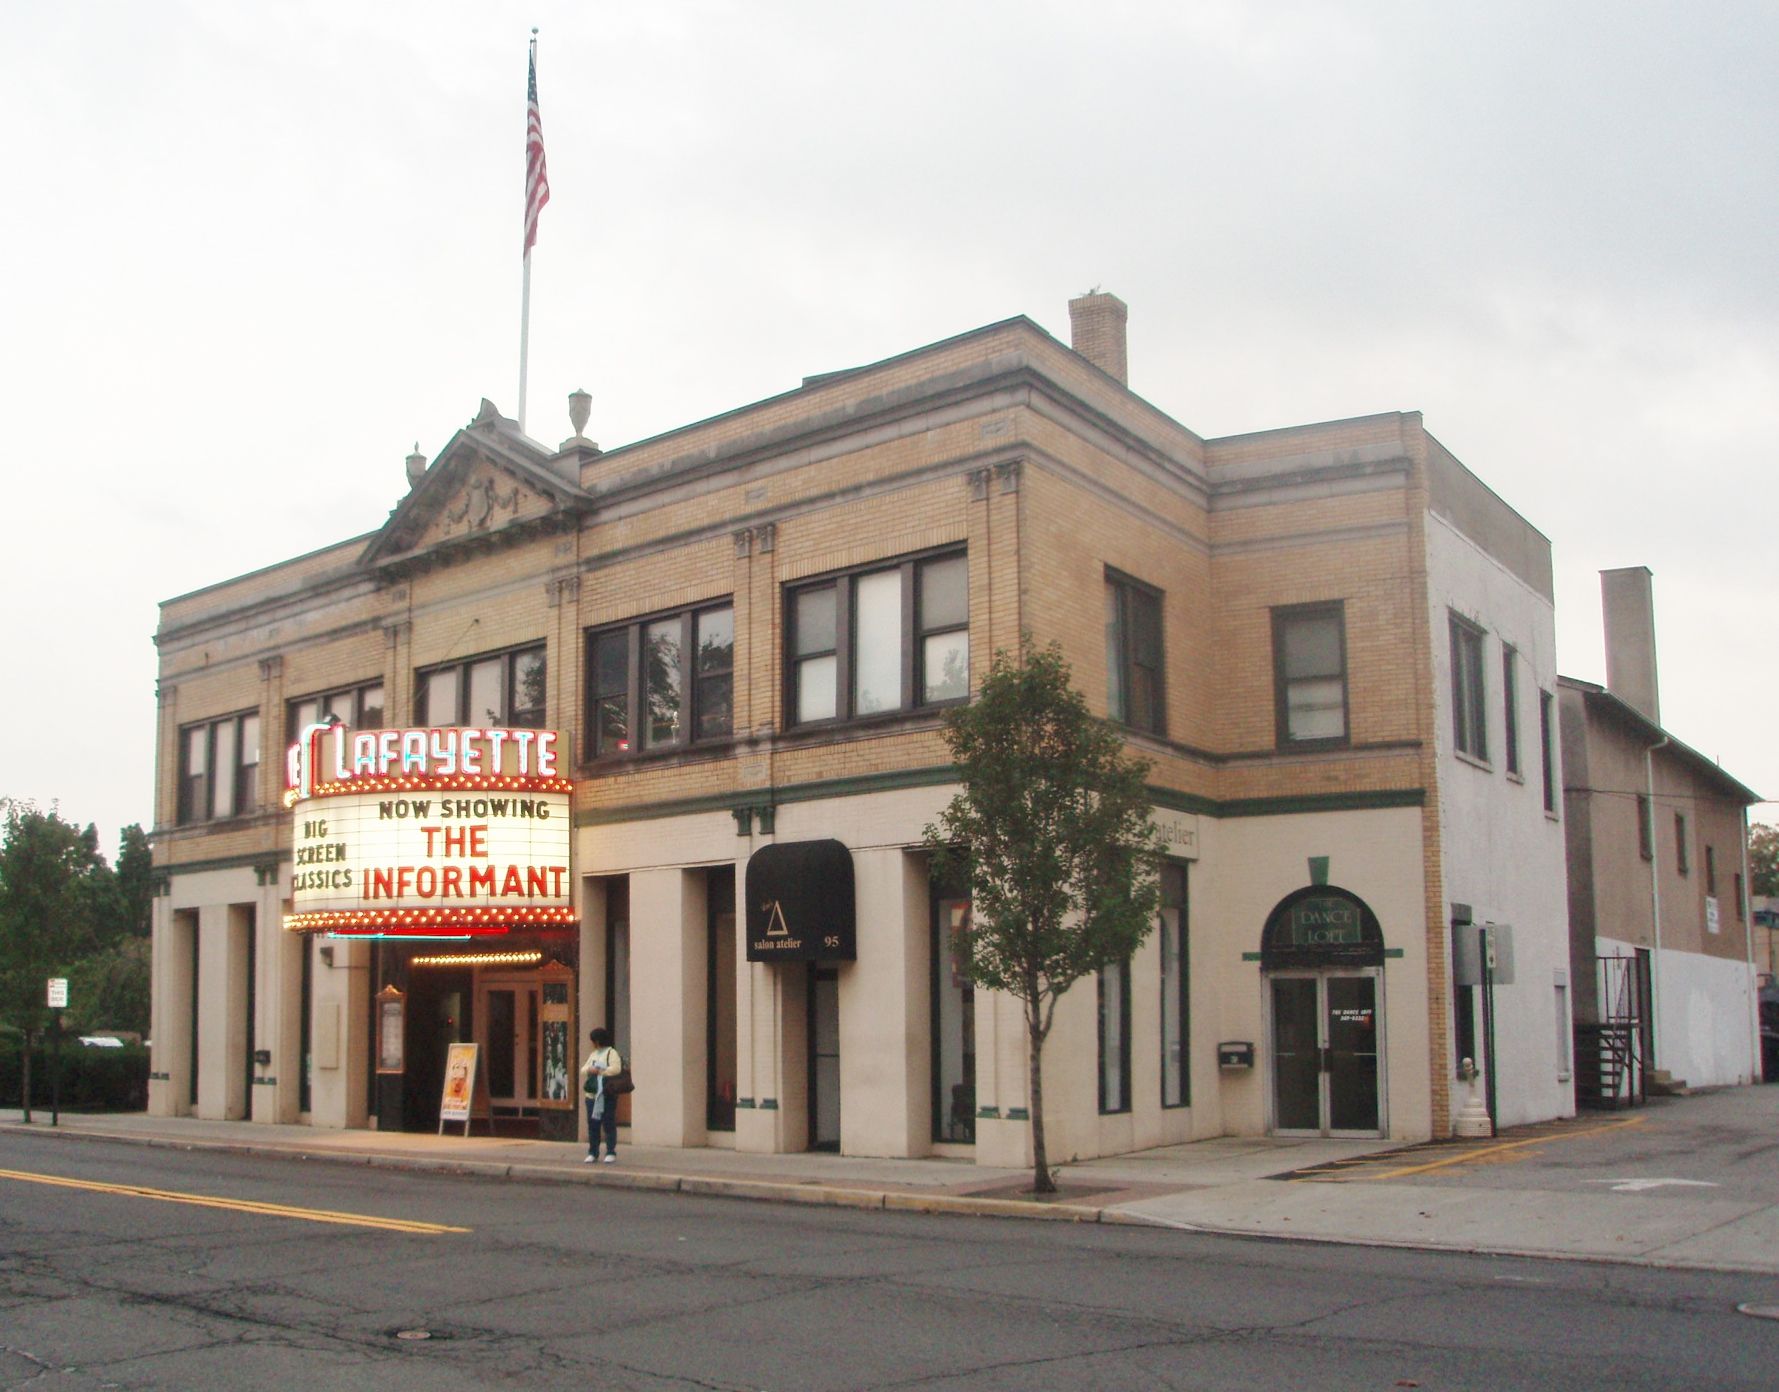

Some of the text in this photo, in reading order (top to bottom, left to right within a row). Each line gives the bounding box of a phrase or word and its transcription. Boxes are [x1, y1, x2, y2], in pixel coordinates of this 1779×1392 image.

[335, 724, 557, 779] LAFAYETTE
[379, 798, 550, 820] NOW SHOWING
[304, 819, 328, 839] BIG
[420, 825, 489, 858] THE
[296, 843, 347, 866] SCREEN
[362, 864, 567, 900] INFORMANT
[1301, 910, 1353, 925] DANCE
[754, 937, 802, 950] salon atelier
[824, 935, 839, 947] 95
